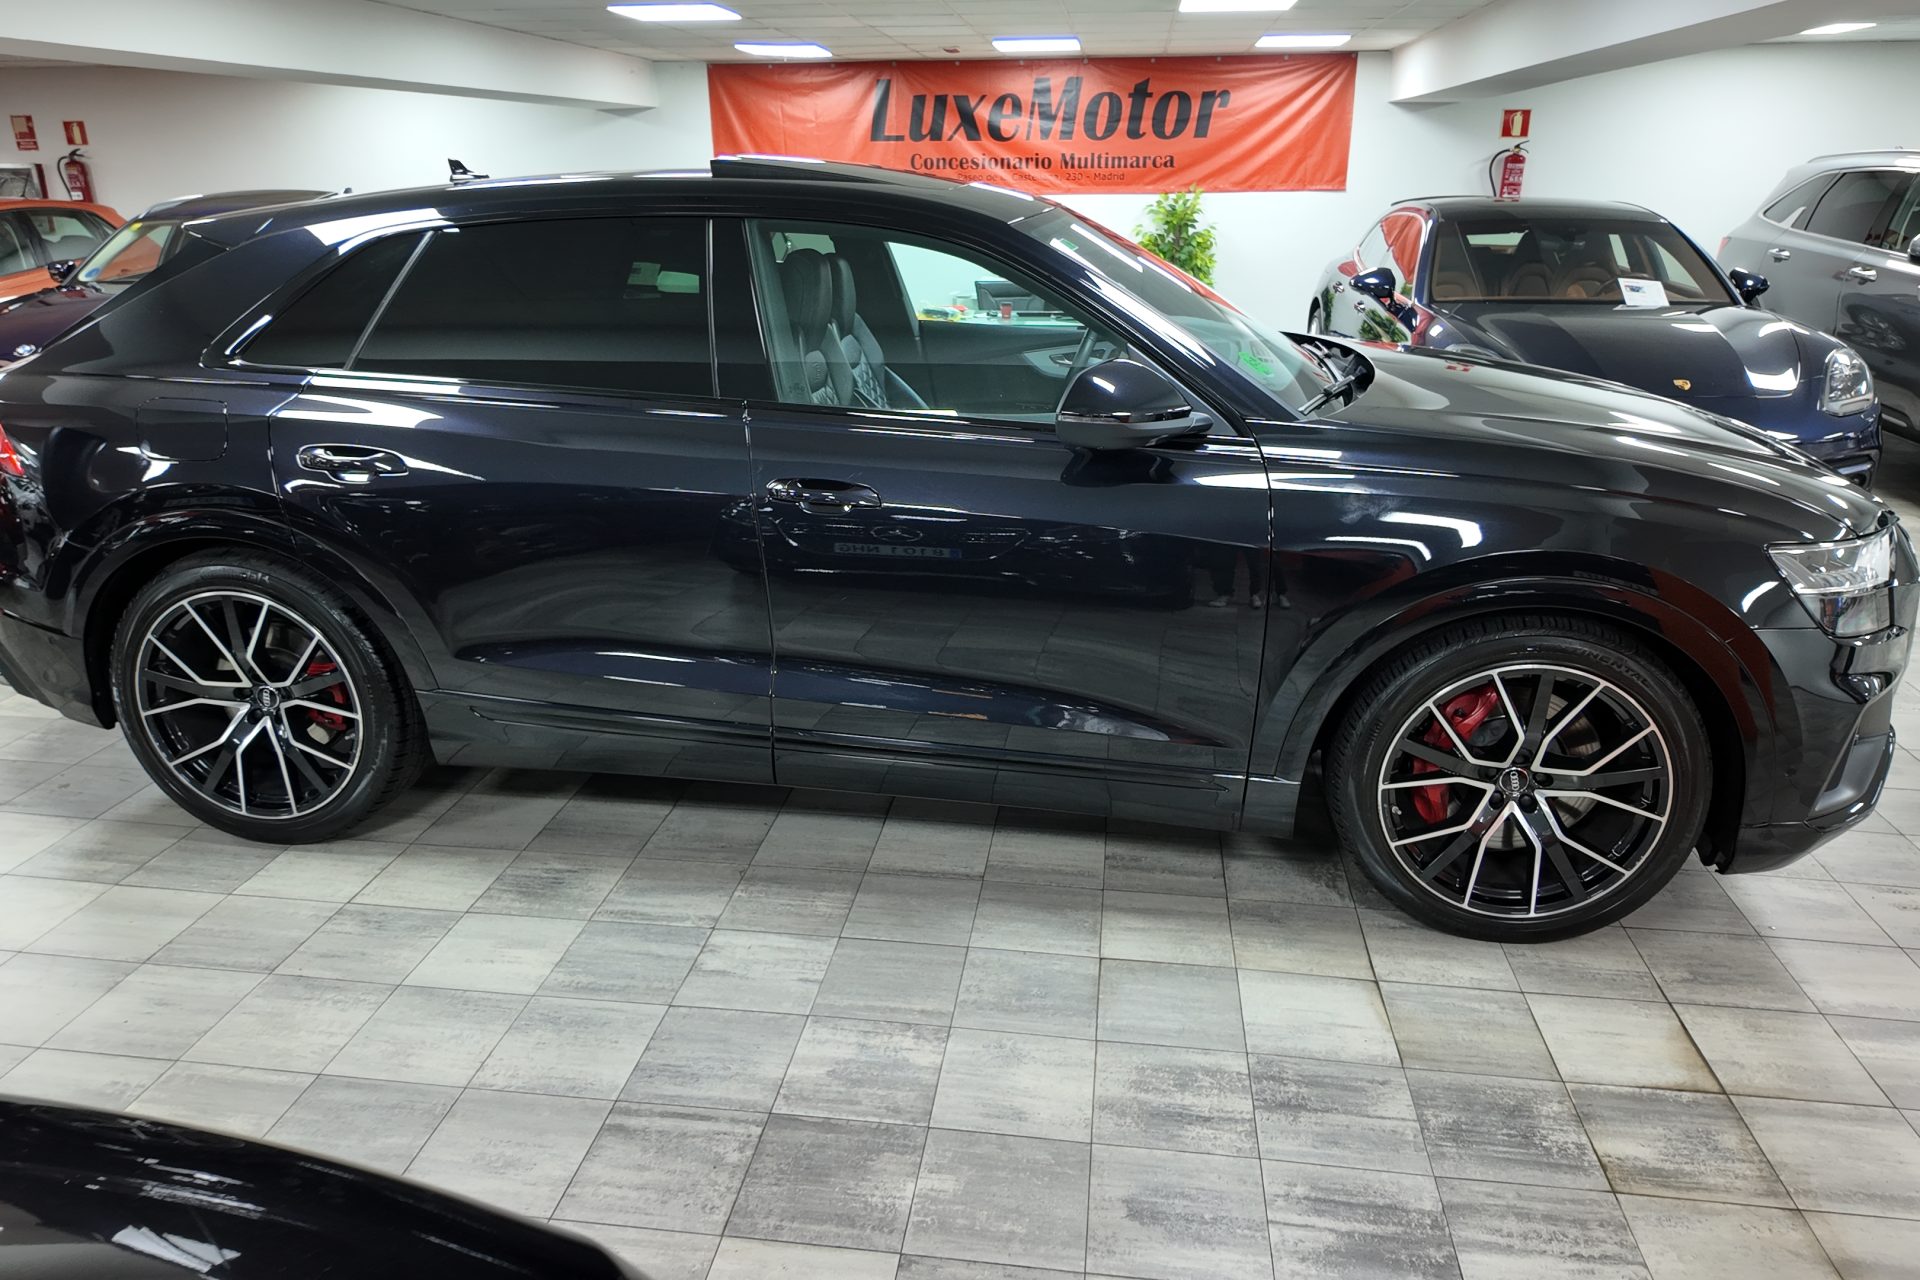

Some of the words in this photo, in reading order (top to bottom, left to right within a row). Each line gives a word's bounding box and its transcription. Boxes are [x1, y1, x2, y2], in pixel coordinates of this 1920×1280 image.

[870, 76, 1232, 142] LuxeMotor
[910, 152, 1051, 170] Concesionario
[1059, 152, 1175, 169] Multimarca
[1093, 172, 1125, 181] Madrid
